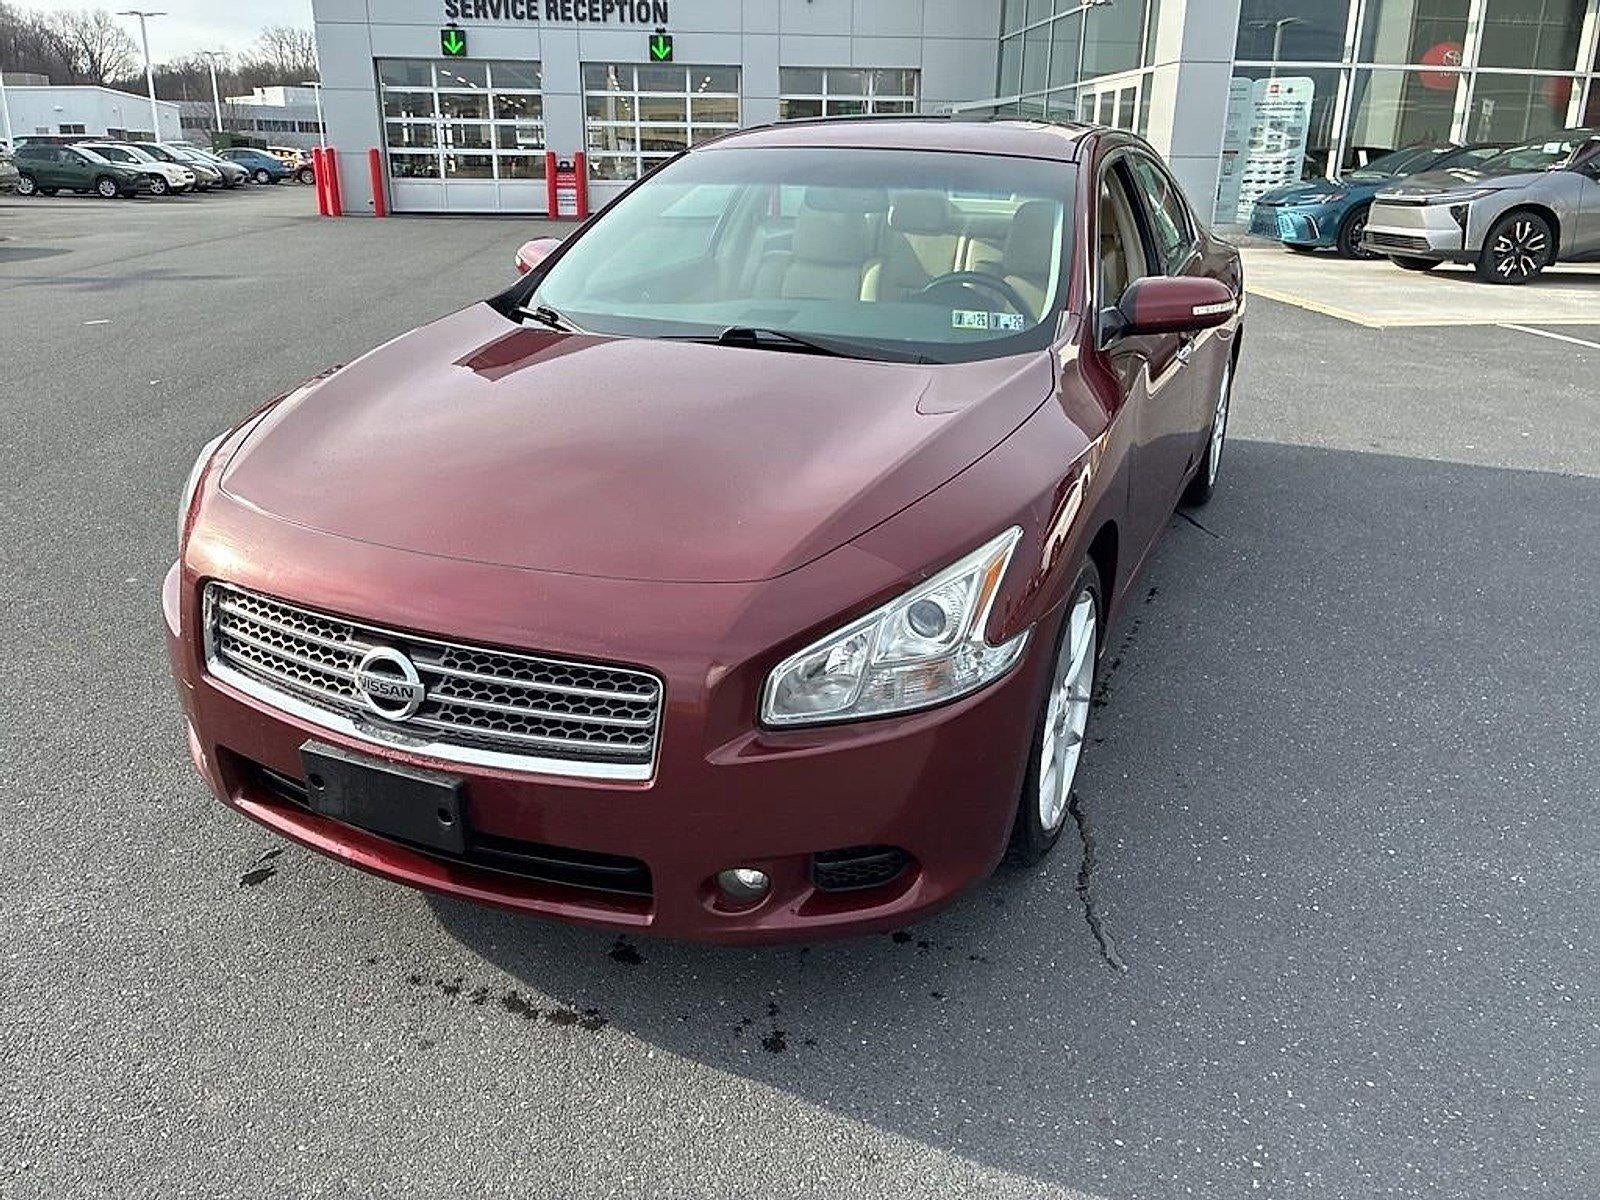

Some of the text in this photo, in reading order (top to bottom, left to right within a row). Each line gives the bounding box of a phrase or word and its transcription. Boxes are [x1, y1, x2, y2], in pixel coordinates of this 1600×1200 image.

[445, 0, 669, 24] SERVICE RECEPTION
[359, 678, 414, 699] NISSAN
